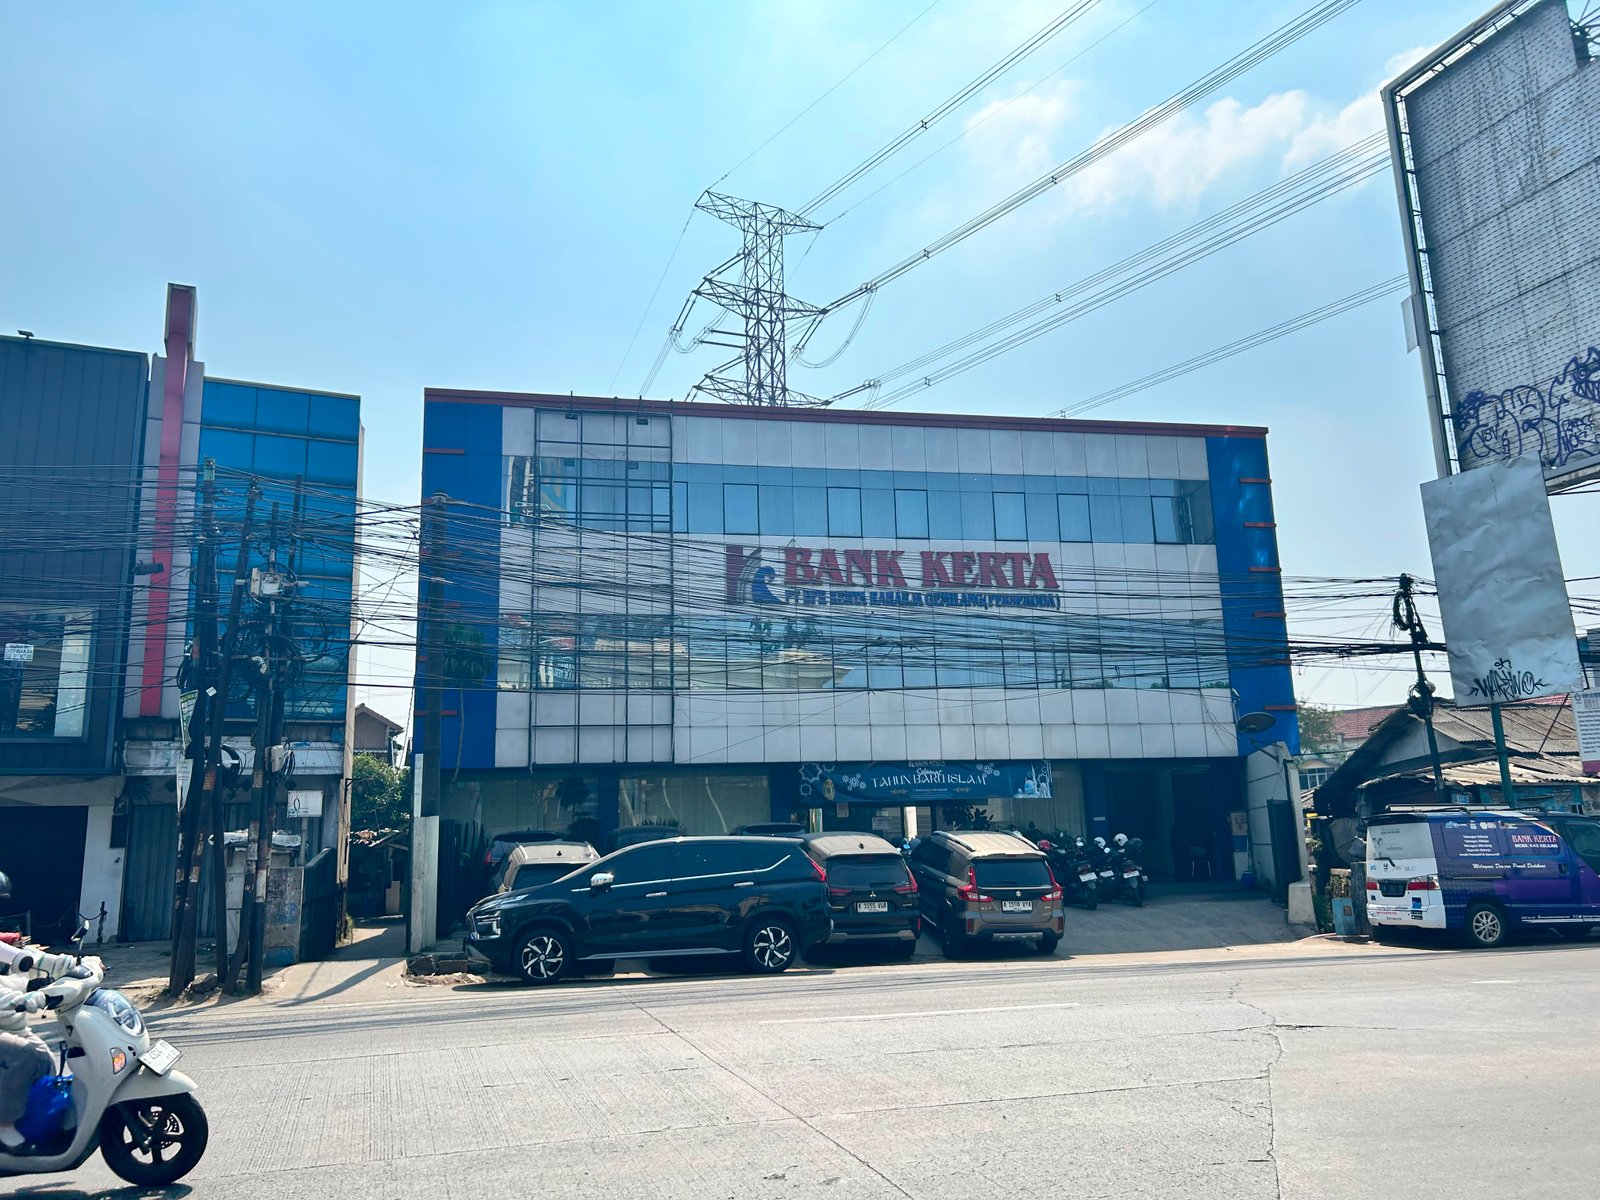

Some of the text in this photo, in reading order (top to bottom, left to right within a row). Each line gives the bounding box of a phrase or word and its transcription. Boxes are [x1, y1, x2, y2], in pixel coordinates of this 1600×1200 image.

[784, 547, 1060, 589] BANK KERTA
[873, 774, 987, 788] TAHUN BARU ISLAM
[1511, 835, 1558, 843] BANK KERTA
